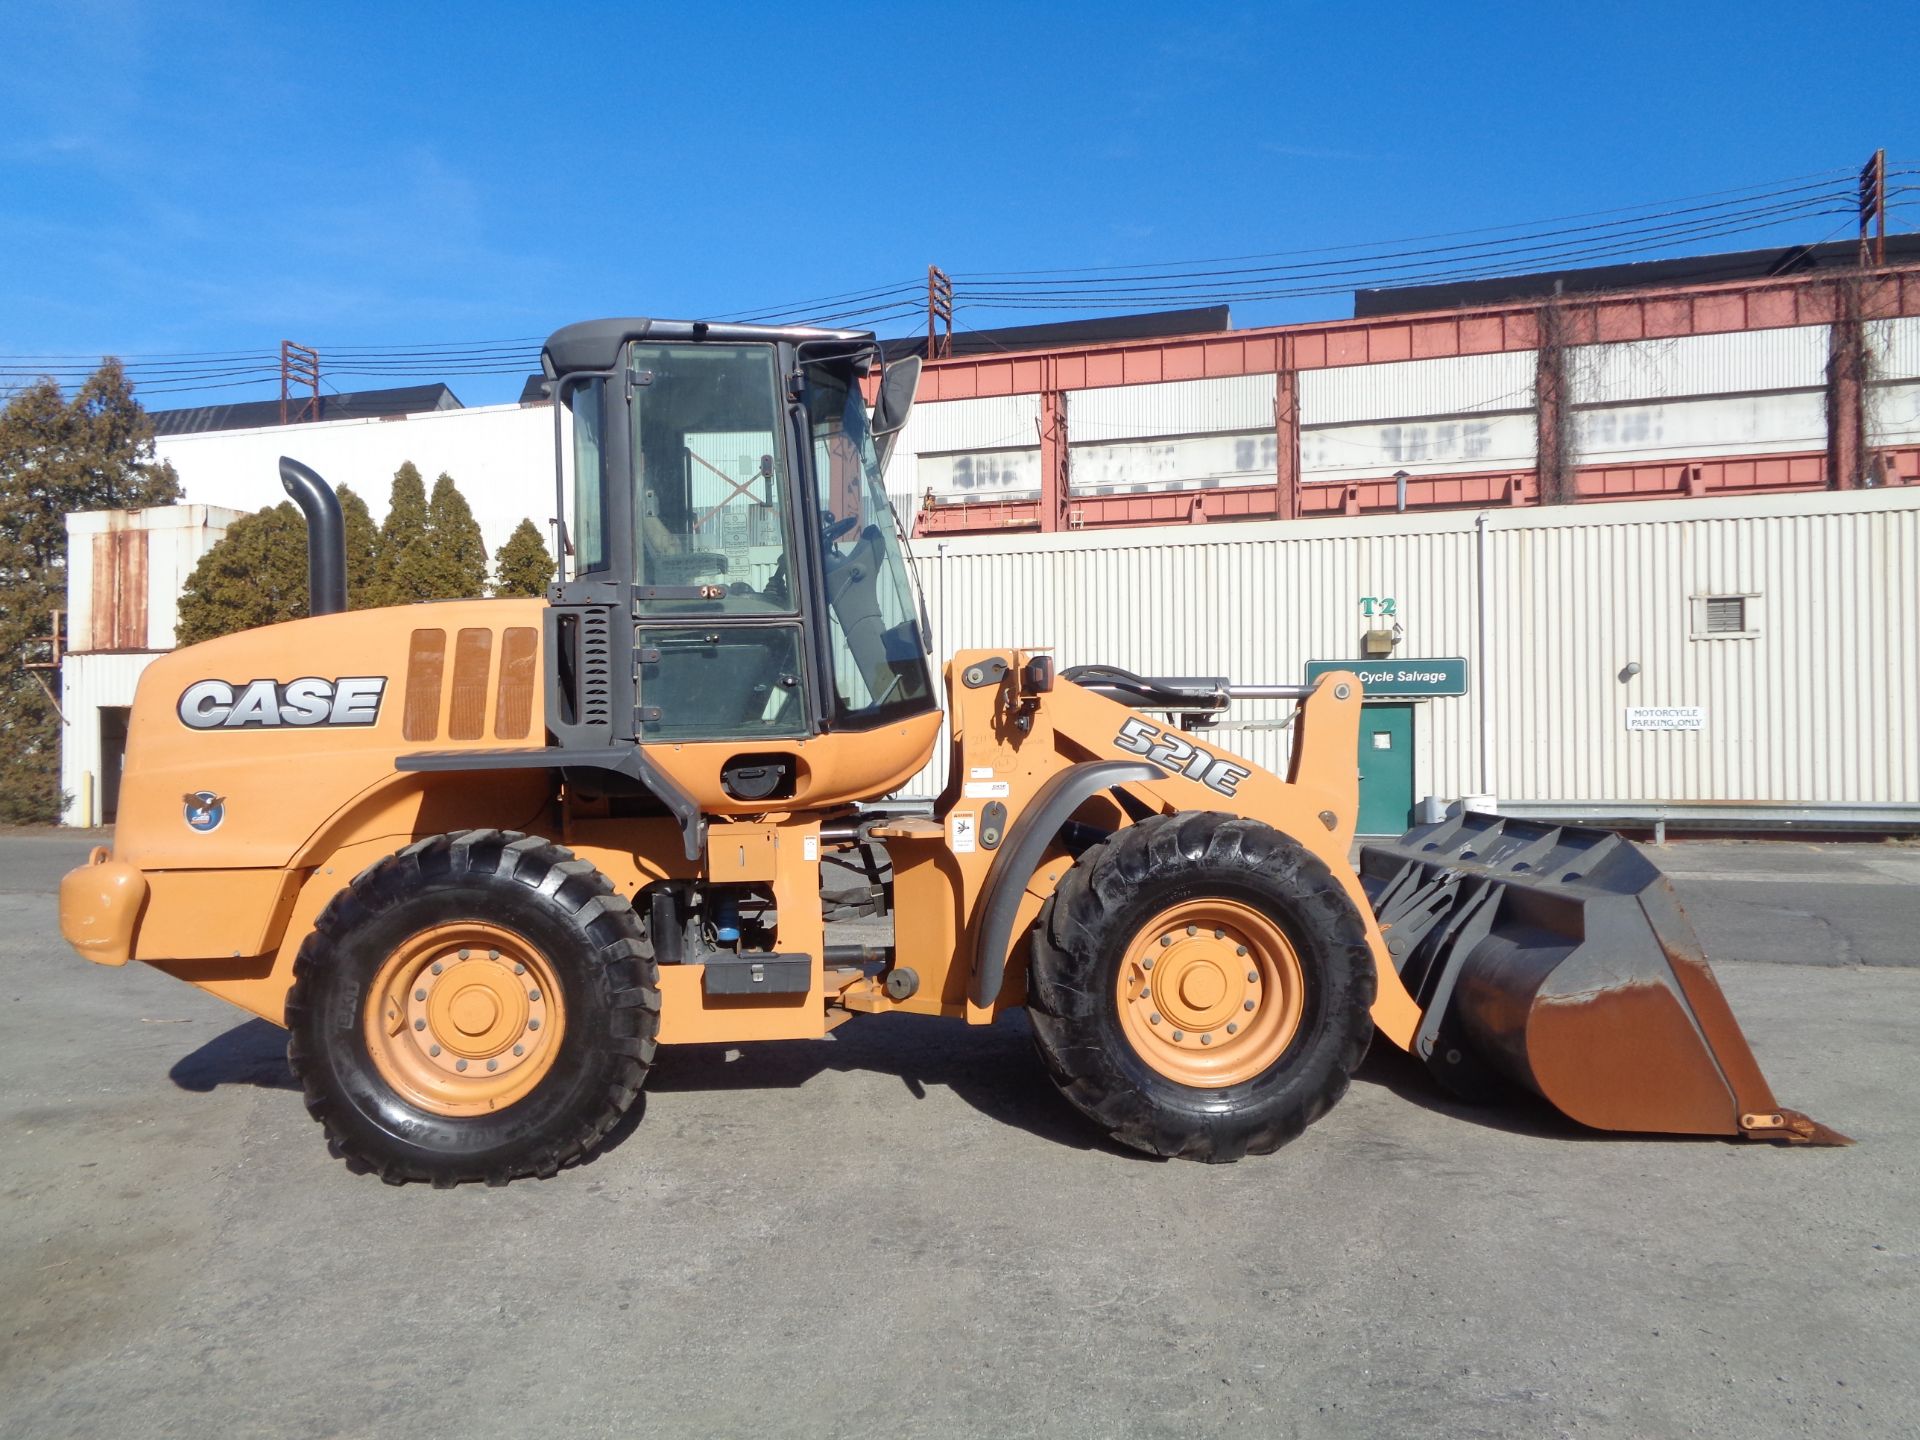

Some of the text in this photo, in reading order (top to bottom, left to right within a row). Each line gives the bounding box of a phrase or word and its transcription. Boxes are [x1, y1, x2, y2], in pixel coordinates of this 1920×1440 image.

[1360, 597, 1397, 617] T2
[1359, 671, 1394, 685] Cycle
[1397, 671, 1446, 684] Salvage
[179, 678, 385, 728] CASE
[1634, 709, 1698, 717] MOTORCYCLE
[1631, 719, 1702, 727] PARKING ONLY
[1113, 716, 1252, 798] 521E
